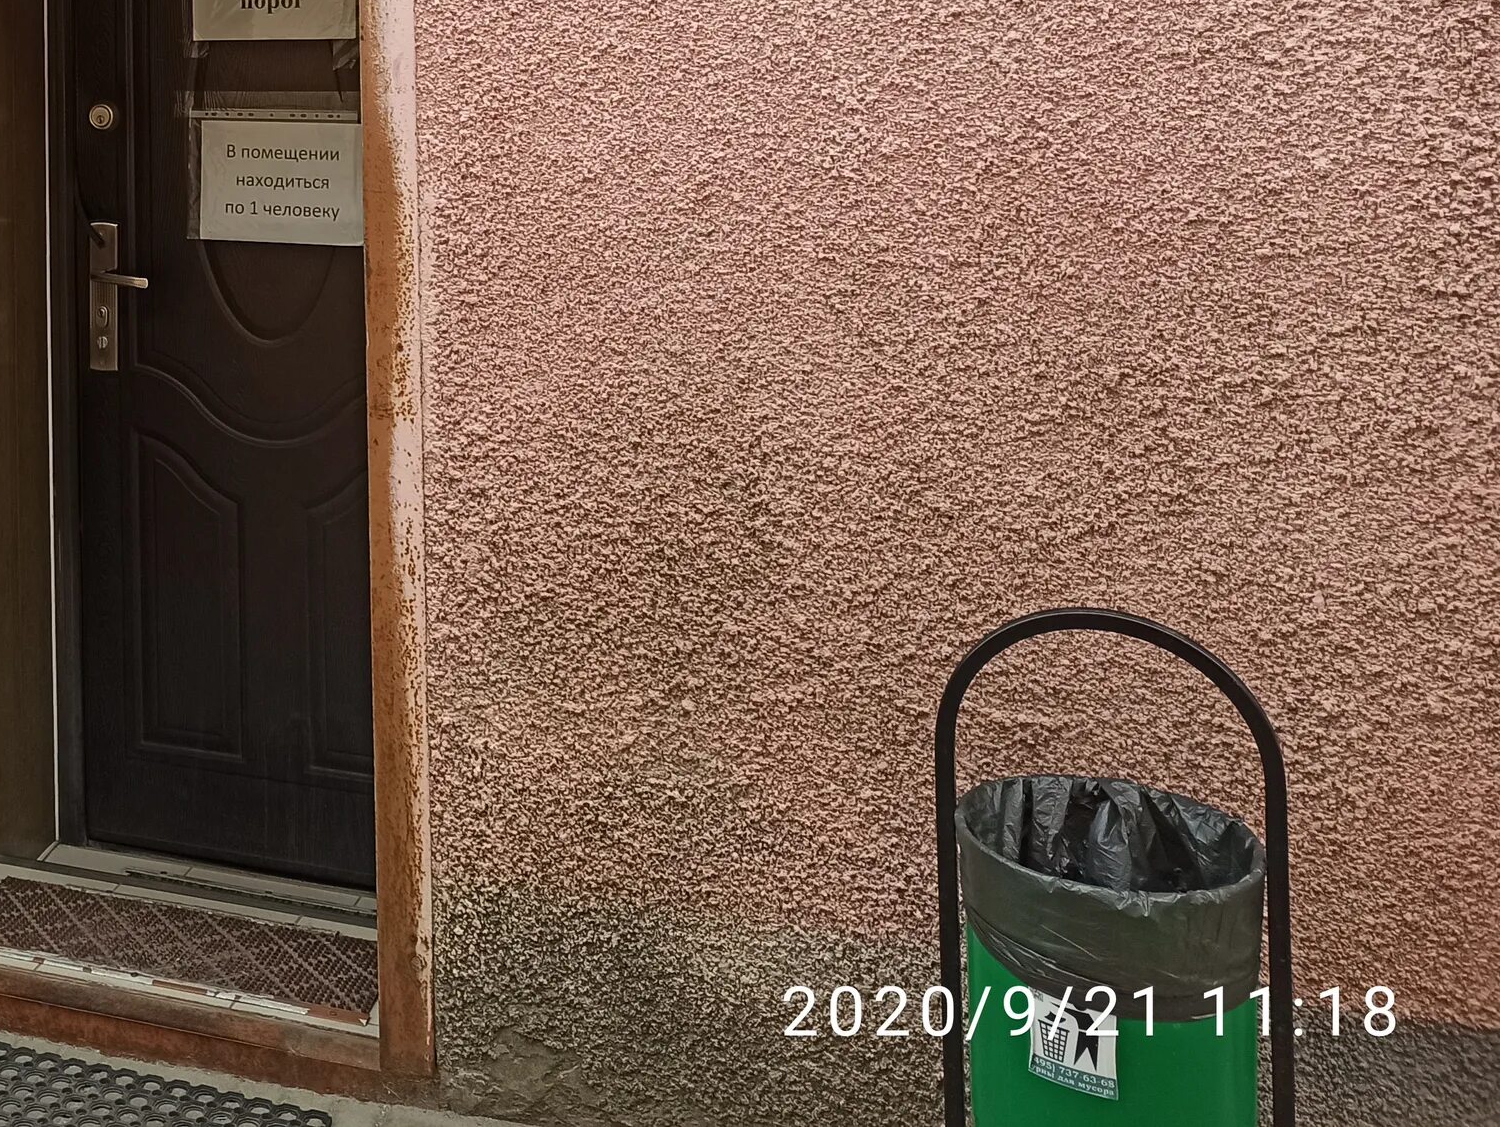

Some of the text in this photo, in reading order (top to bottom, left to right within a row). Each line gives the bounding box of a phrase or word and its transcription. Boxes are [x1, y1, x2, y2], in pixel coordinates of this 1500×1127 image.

[226, 144, 340, 163] В помещении
[235, 174, 330, 191] находиться
[224, 200, 340, 222] по 1 человеку
[1057, 1075, 1075, 1086] для
[1077, 1081, 1115, 1096] мусора
[1058, 1066, 1116, 1088] 737-63-68
